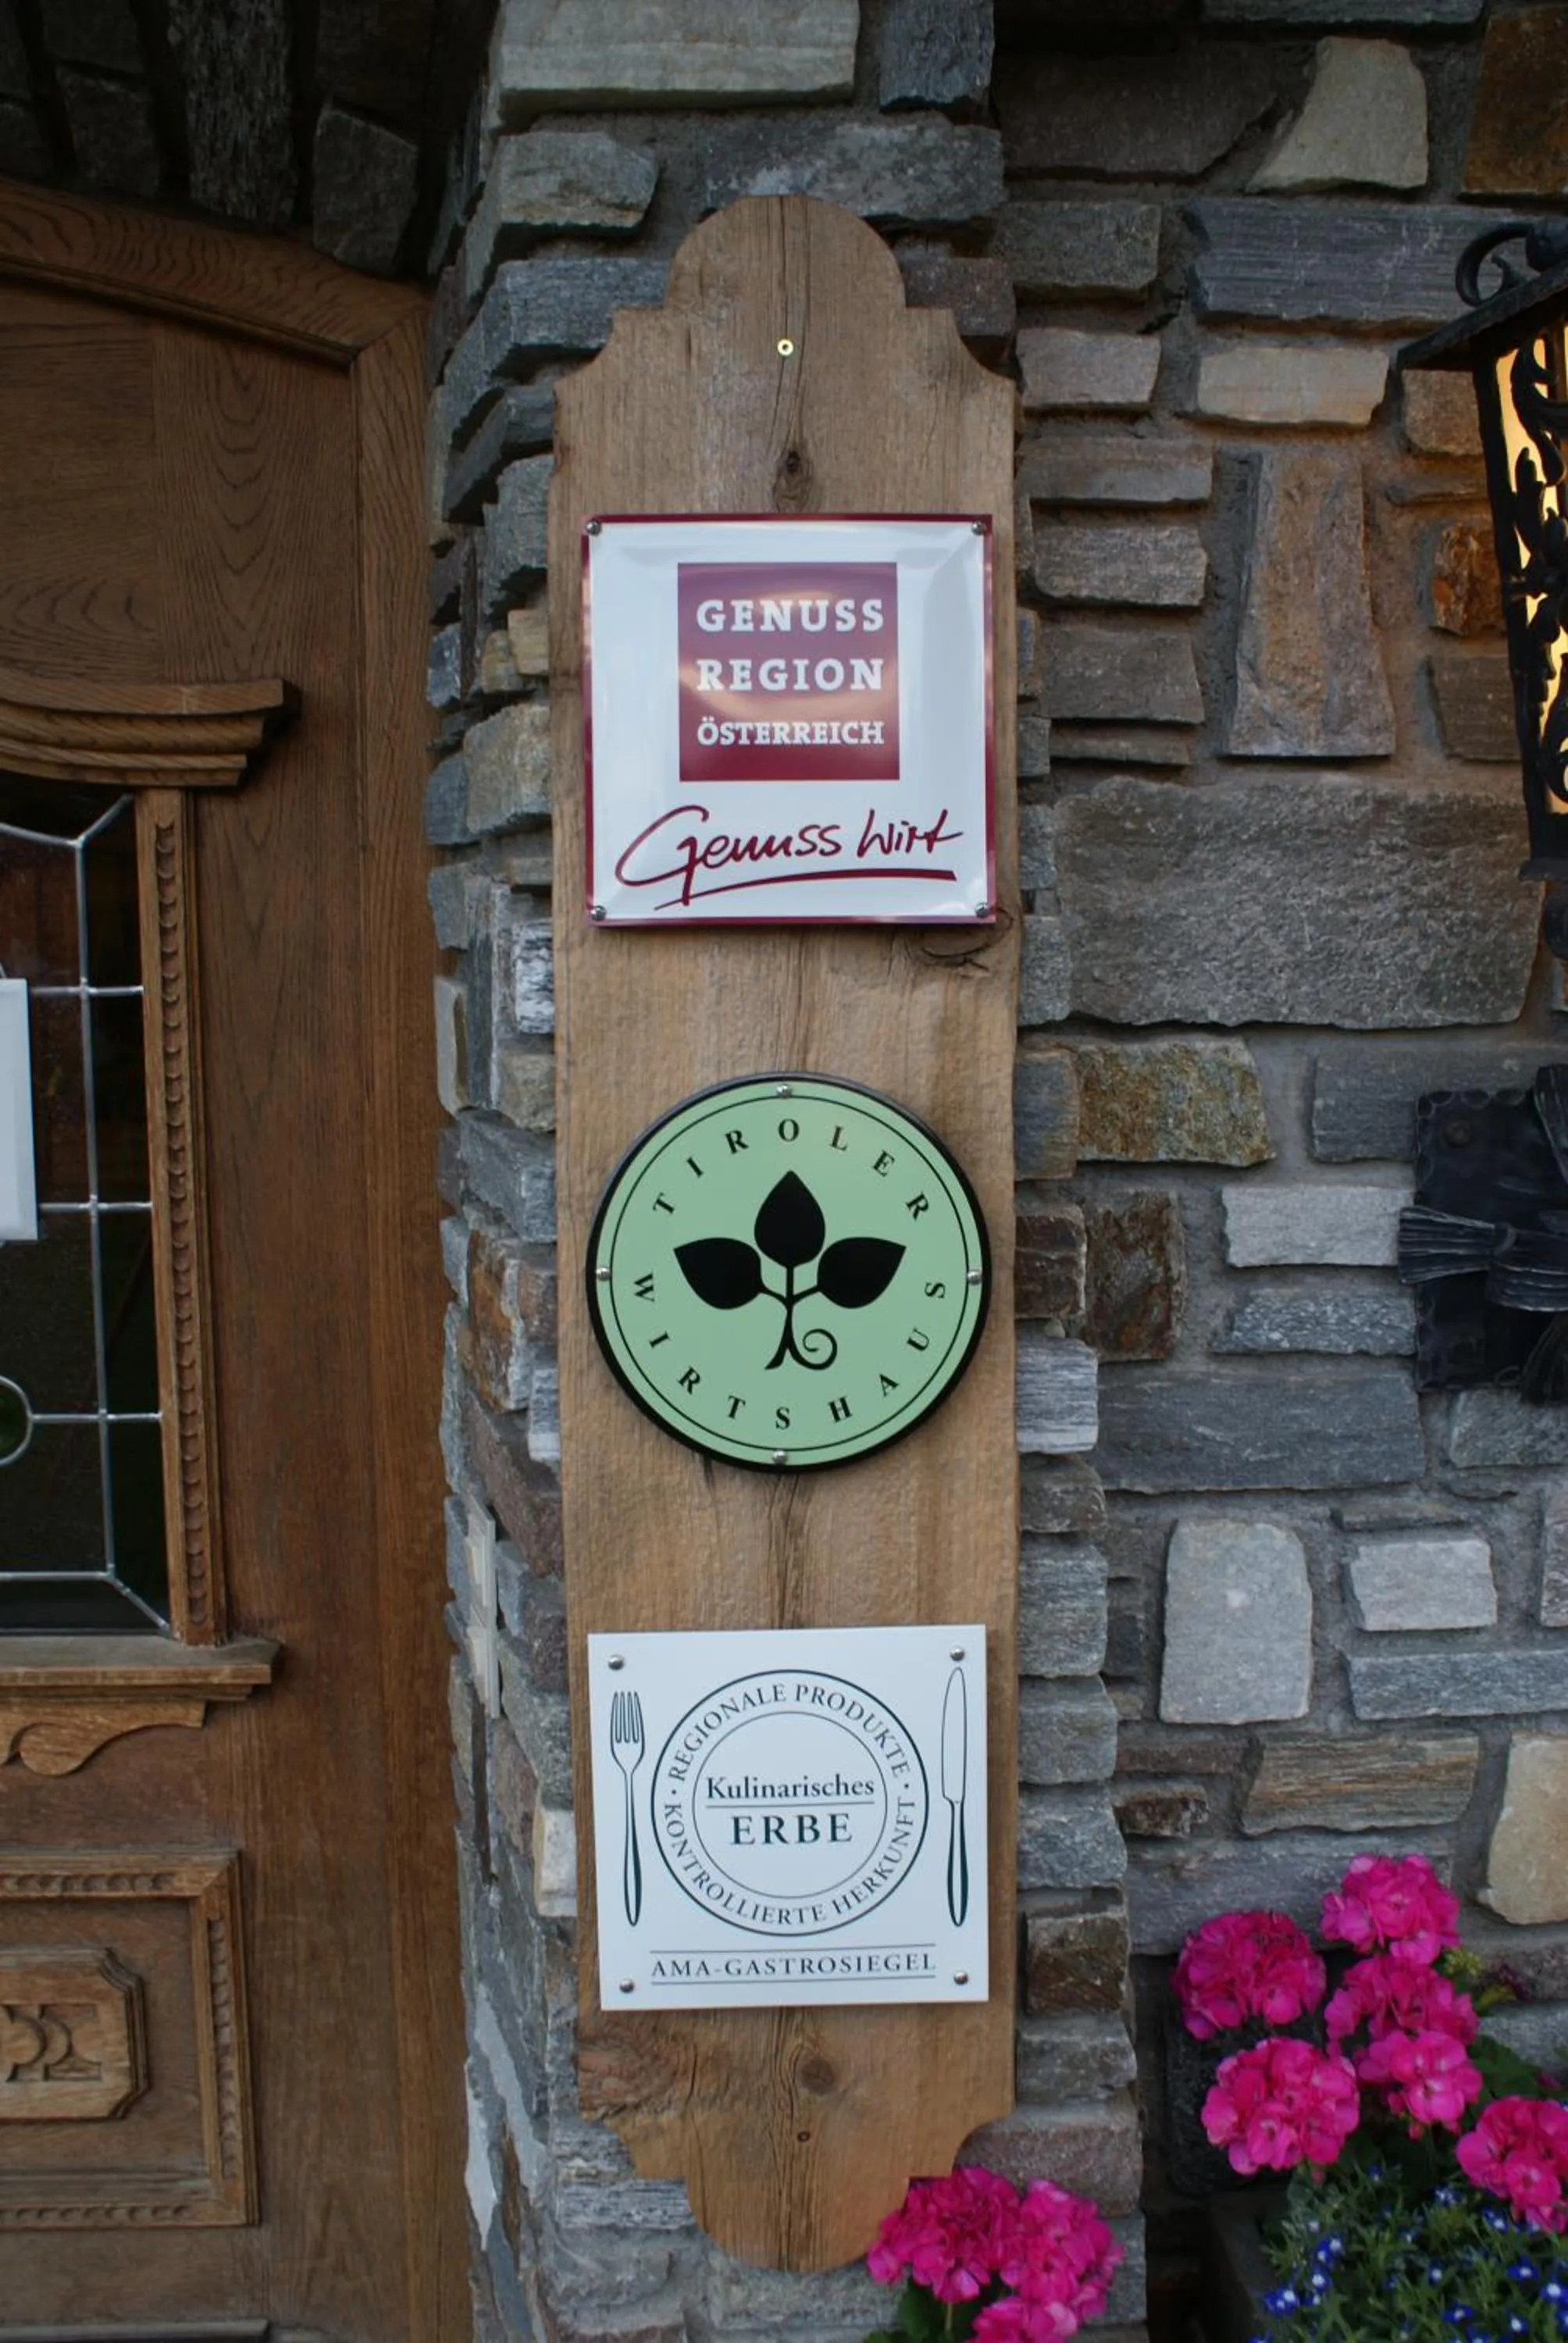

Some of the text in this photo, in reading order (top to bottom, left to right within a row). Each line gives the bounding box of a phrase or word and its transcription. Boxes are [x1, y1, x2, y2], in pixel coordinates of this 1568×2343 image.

[696, 598, 884, 632] GENUSS
[696, 658, 884, 691] REGION
[697, 715, 885, 746] ÖSTERREICH
[615, 804, 964, 905] Genuss Wirt
[652, 1118, 929, 1220] TIROLER
[633, 1272, 946, 1430] WIRTSHAUS
[668, 1682, 911, 1783] REGIONALE PRODUKTE
[707, 1773, 875, 1799] Kulinarisches
[730, 1813, 853, 1846] ERBE
[664, 1796, 915, 1926] KONTROLLIERTE HERKUNFT
[651, 1952, 936, 1977] AMA-GASTROSIEGEL
